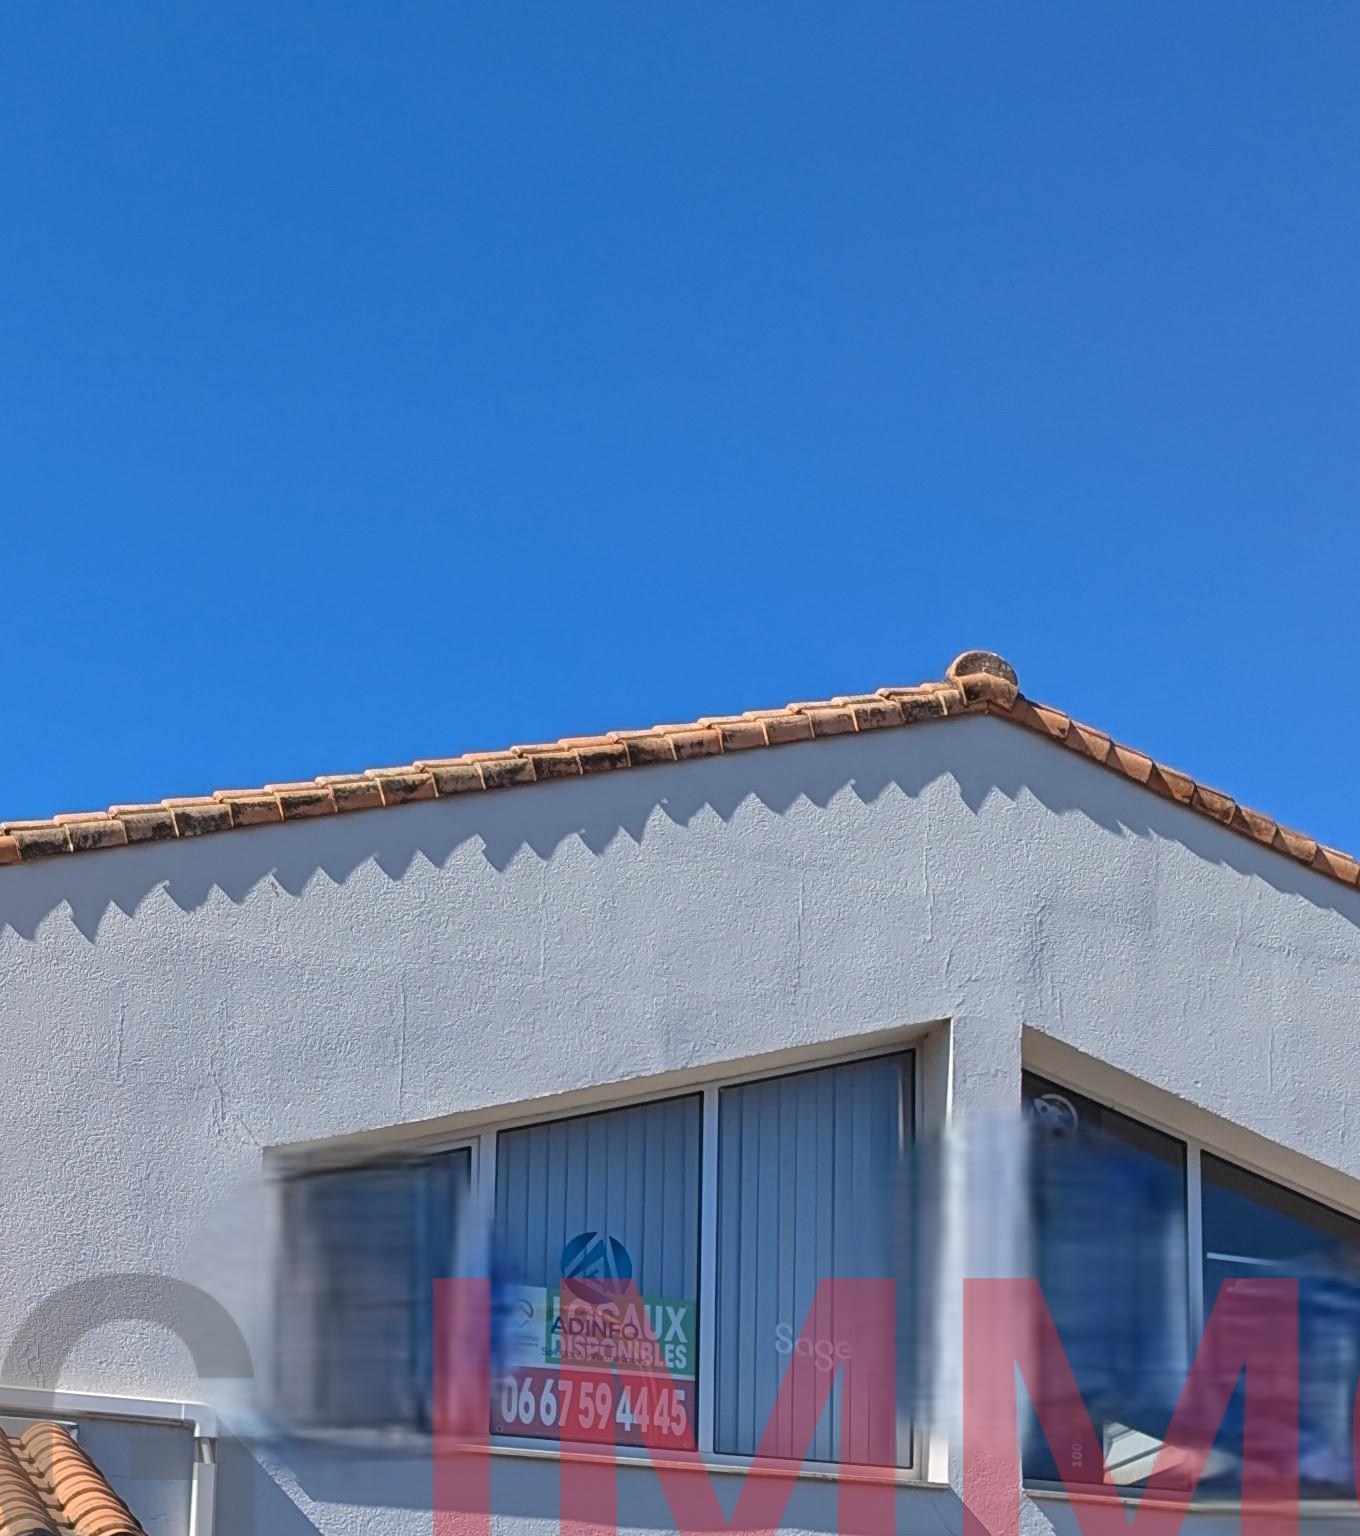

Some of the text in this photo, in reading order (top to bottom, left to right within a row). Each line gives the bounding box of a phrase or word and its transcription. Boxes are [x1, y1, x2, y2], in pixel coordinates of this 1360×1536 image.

[552, 1296, 688, 1343] LOCAUX
[552, 1335, 688, 1369] DISPONIBLES
[775, 1323, 852, 1372] Sage
[501, 1375, 687, 1436] 06 67 59 44 45
